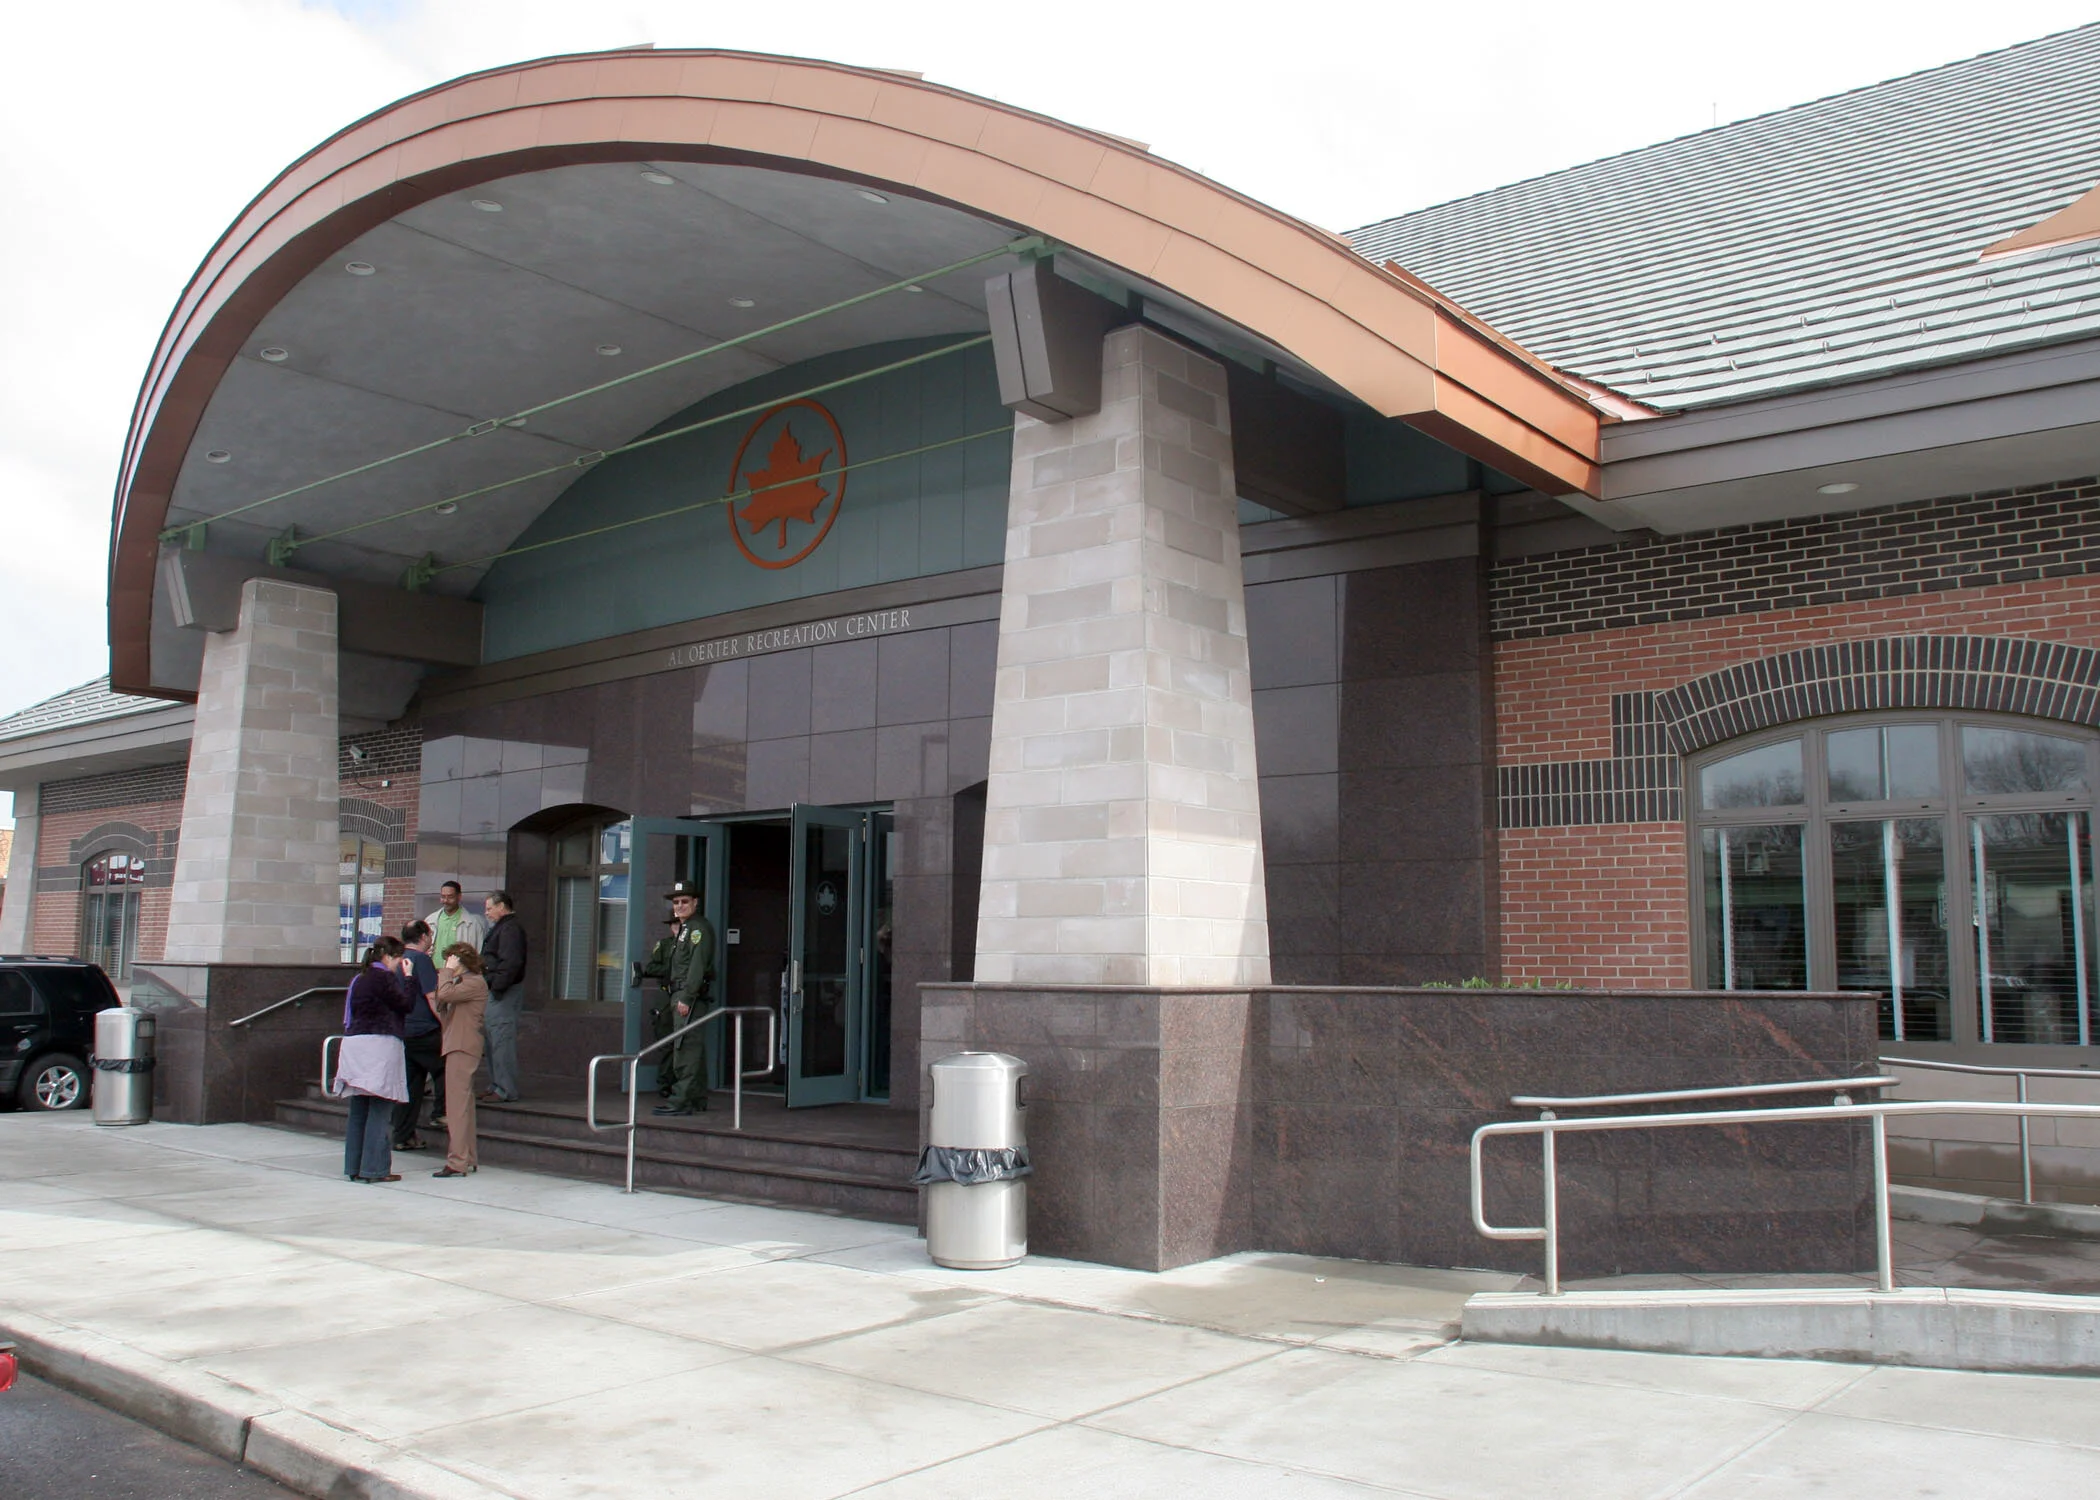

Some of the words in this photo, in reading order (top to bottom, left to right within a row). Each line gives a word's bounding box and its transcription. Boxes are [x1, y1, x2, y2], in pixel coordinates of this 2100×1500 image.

[668, 651, 684, 667] AL
[689, 638, 738, 663] OERTER
[747, 620, 837, 652] RECREATION
[846, 609, 911, 636] CENTER
